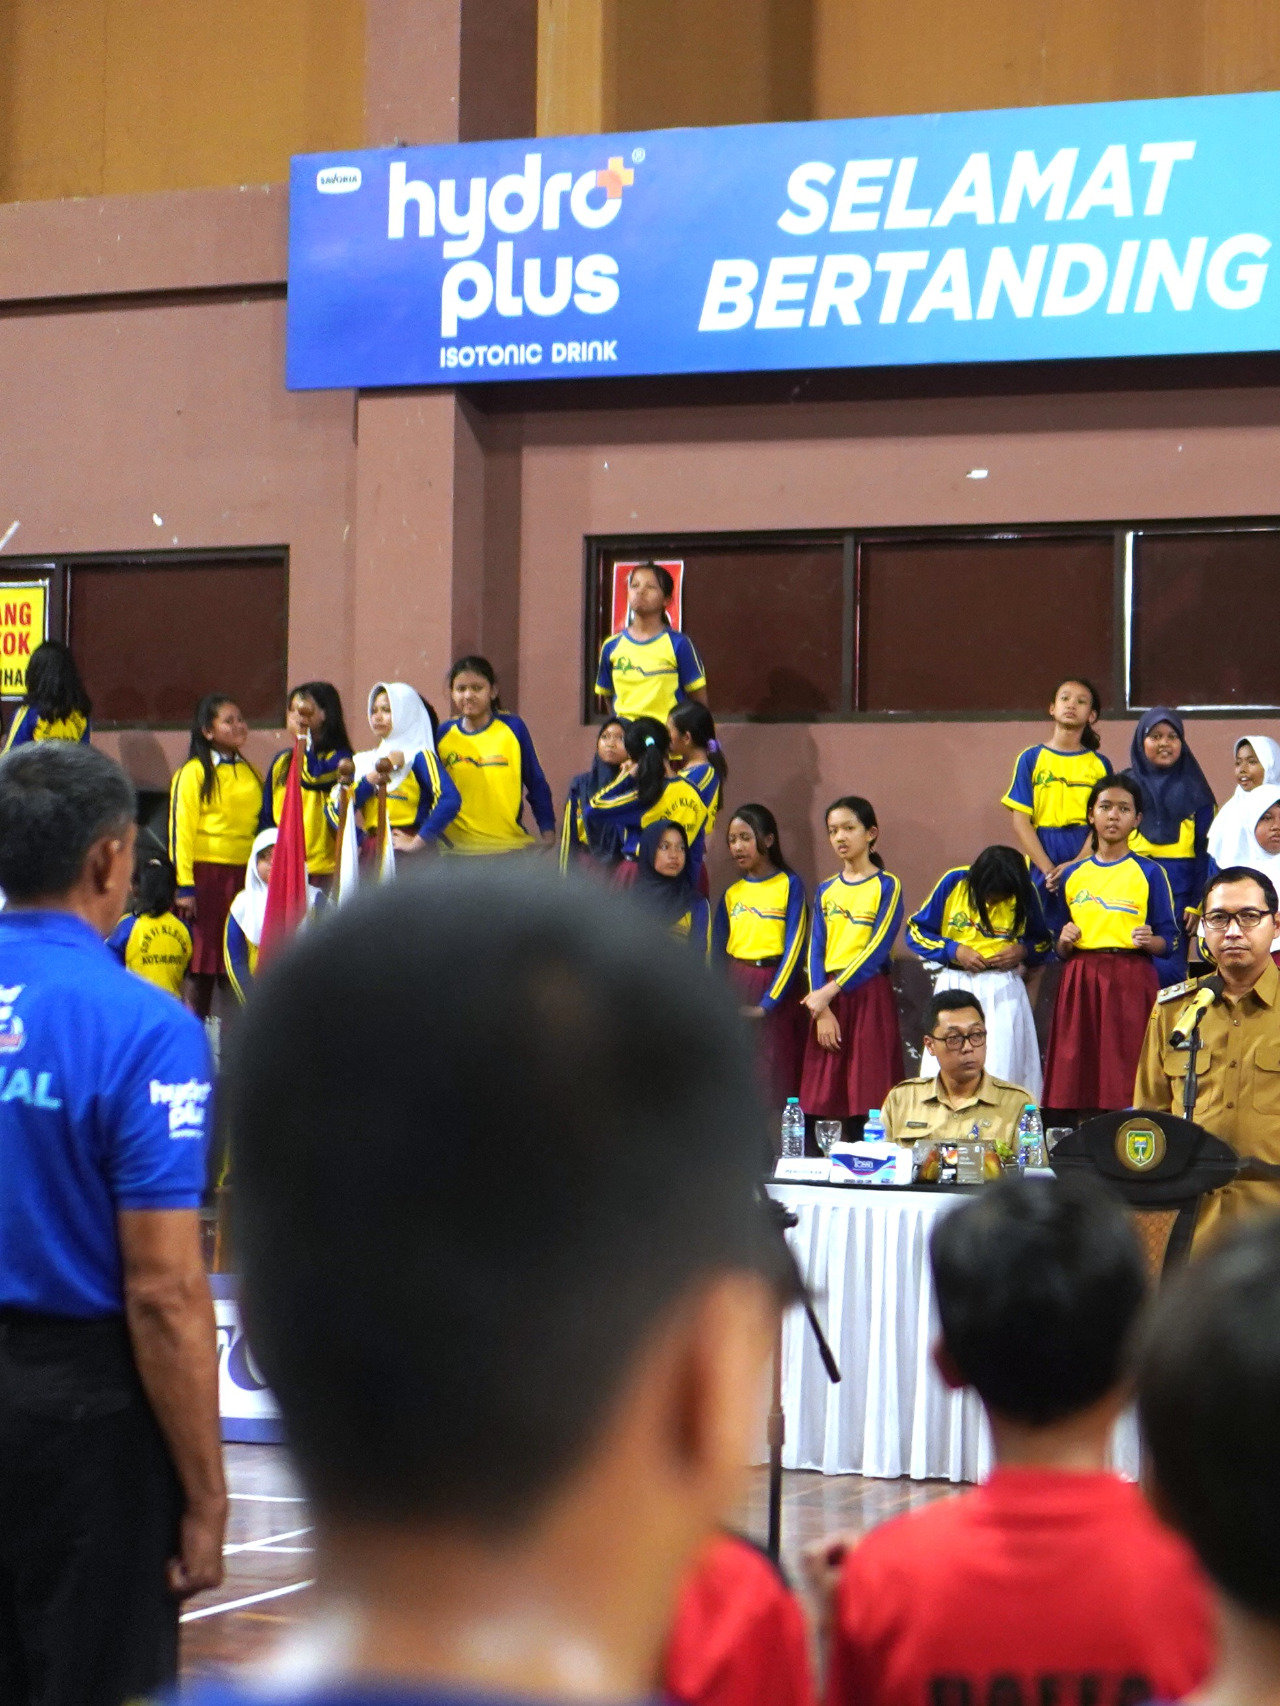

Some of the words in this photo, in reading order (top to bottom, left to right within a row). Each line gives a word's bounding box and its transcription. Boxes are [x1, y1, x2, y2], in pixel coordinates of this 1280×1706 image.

[388, 153, 625, 258] hydro
[777, 140, 1197, 235] SELAMAT
[440, 241, 620, 338] plus
[698, 233, 1273, 332] BERTANDING
[440, 343, 543, 368] ISOTONIC
[551, 340, 619, 364] DRINK
[0, 602, 32, 627] NG
[0, 631, 31, 656] OK
[0, 1066, 63, 1110] AL
